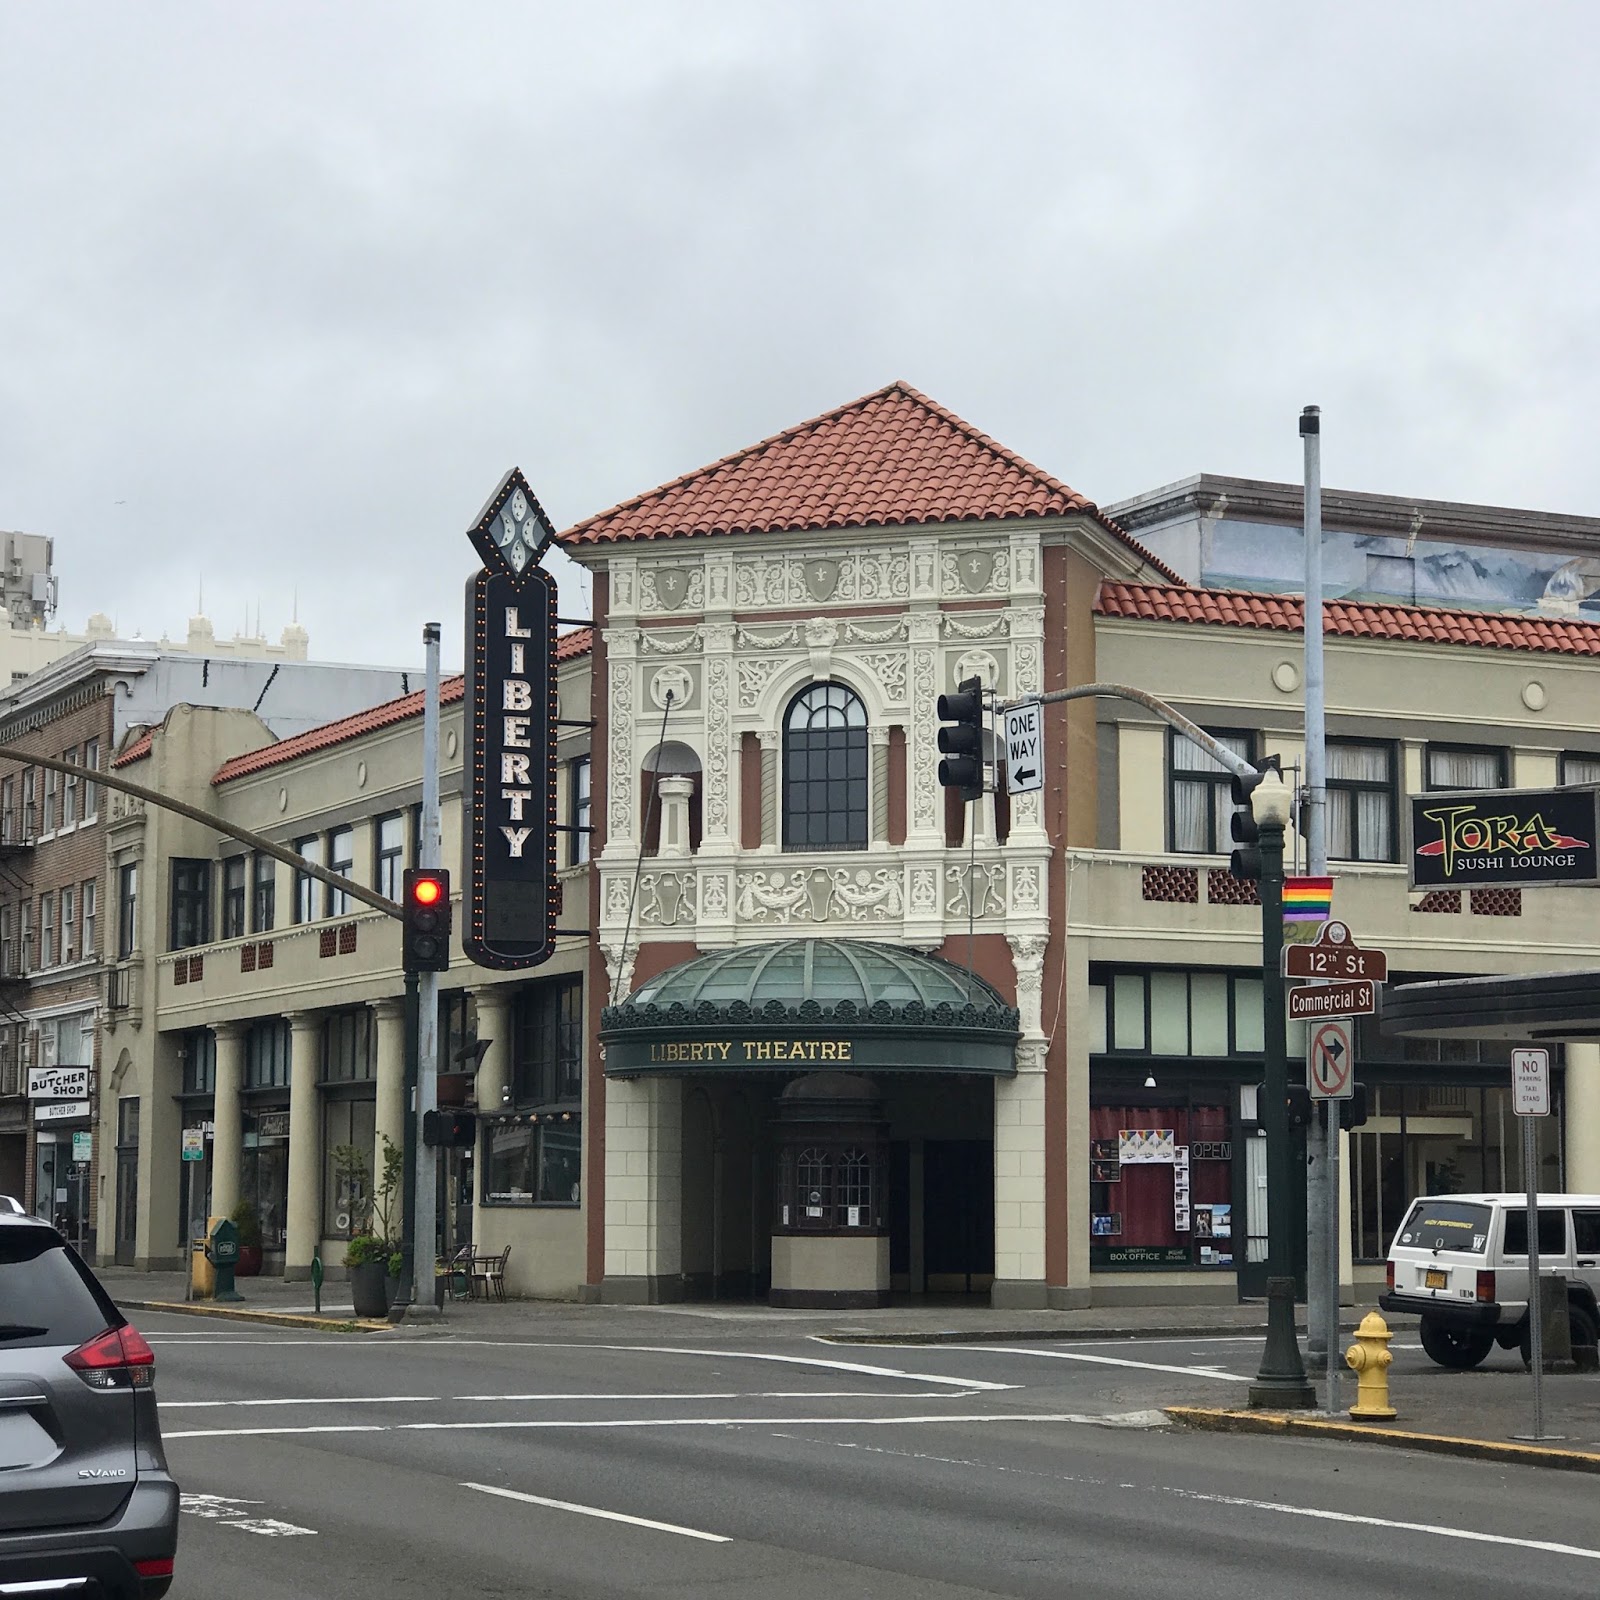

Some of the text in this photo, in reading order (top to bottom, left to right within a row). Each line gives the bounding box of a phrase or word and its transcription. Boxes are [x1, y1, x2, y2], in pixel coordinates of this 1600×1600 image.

[500, 606, 532, 858] LIBERTY
[1010, 712, 1036, 736] ONE
[1010, 737, 1037, 761] WAY
[1423, 805, 1562, 877] TORA
[1457, 854, 1576, 870] SUSHI LOUNGE
[1309, 952, 1365, 975] 12th St
[1292, 987, 1370, 1013] Commercial St
[650, 1041, 852, 1062] LIBERTY THEATRE
[1522, 1060, 1538, 1073] NO
[31, 1072, 85, 1091] BUTCHER
[53, 1085, 84, 1095] SHOP
[1193, 1143, 1230, 1158] OPEN
[1473, 1237, 1485, 1249] W
[1110, 1253, 1128, 1261] BOX
[1128, 1252, 1160, 1260] OFFICE
